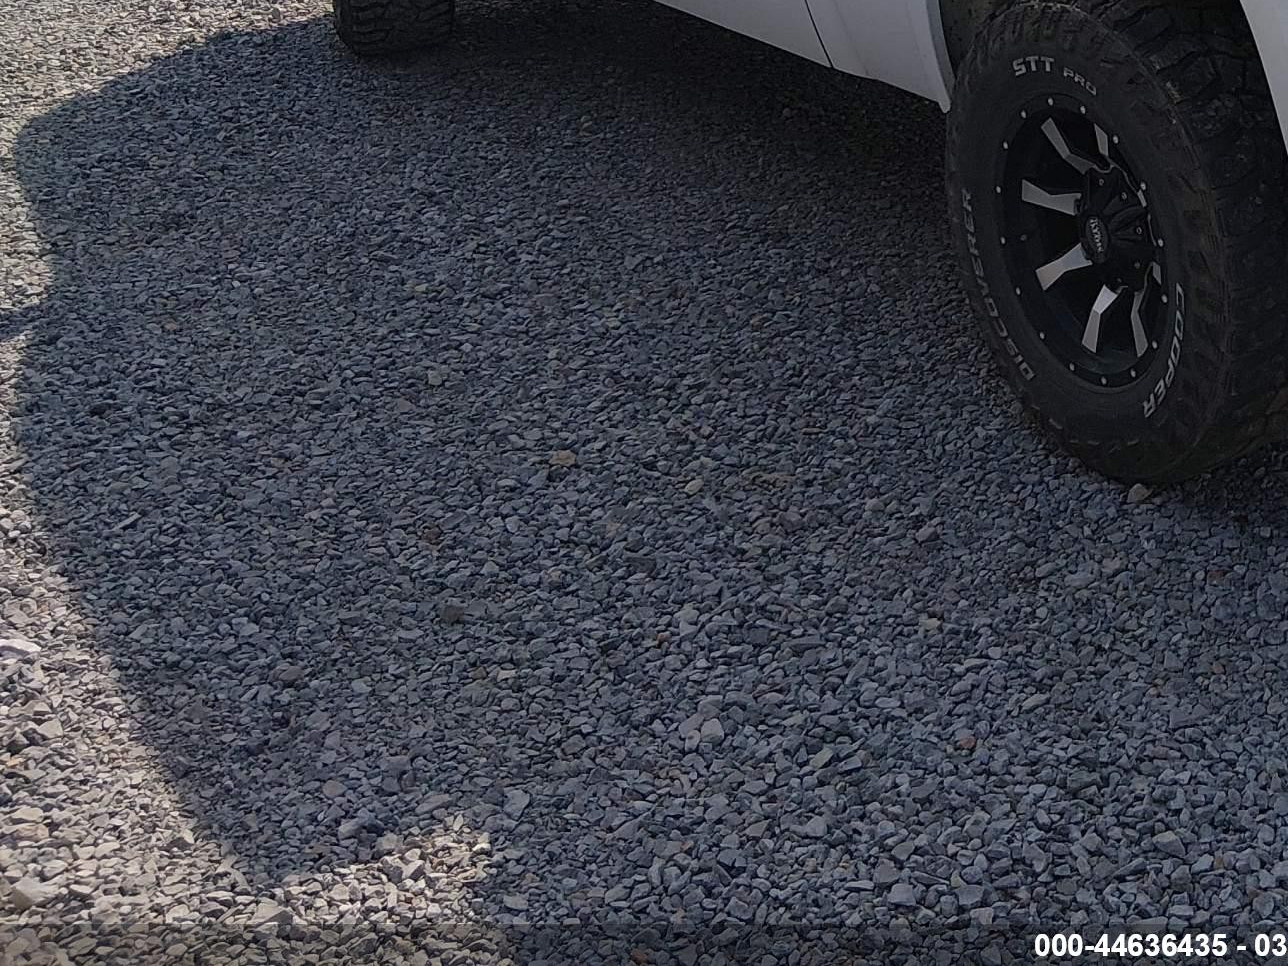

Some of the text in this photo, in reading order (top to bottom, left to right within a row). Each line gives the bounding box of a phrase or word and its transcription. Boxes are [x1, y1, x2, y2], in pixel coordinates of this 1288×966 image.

[1012, 55, 1097, 96] STT PRO
[961, 188, 1036, 380] DISCOVERER
[1143, 282, 1185, 419] COOPER
